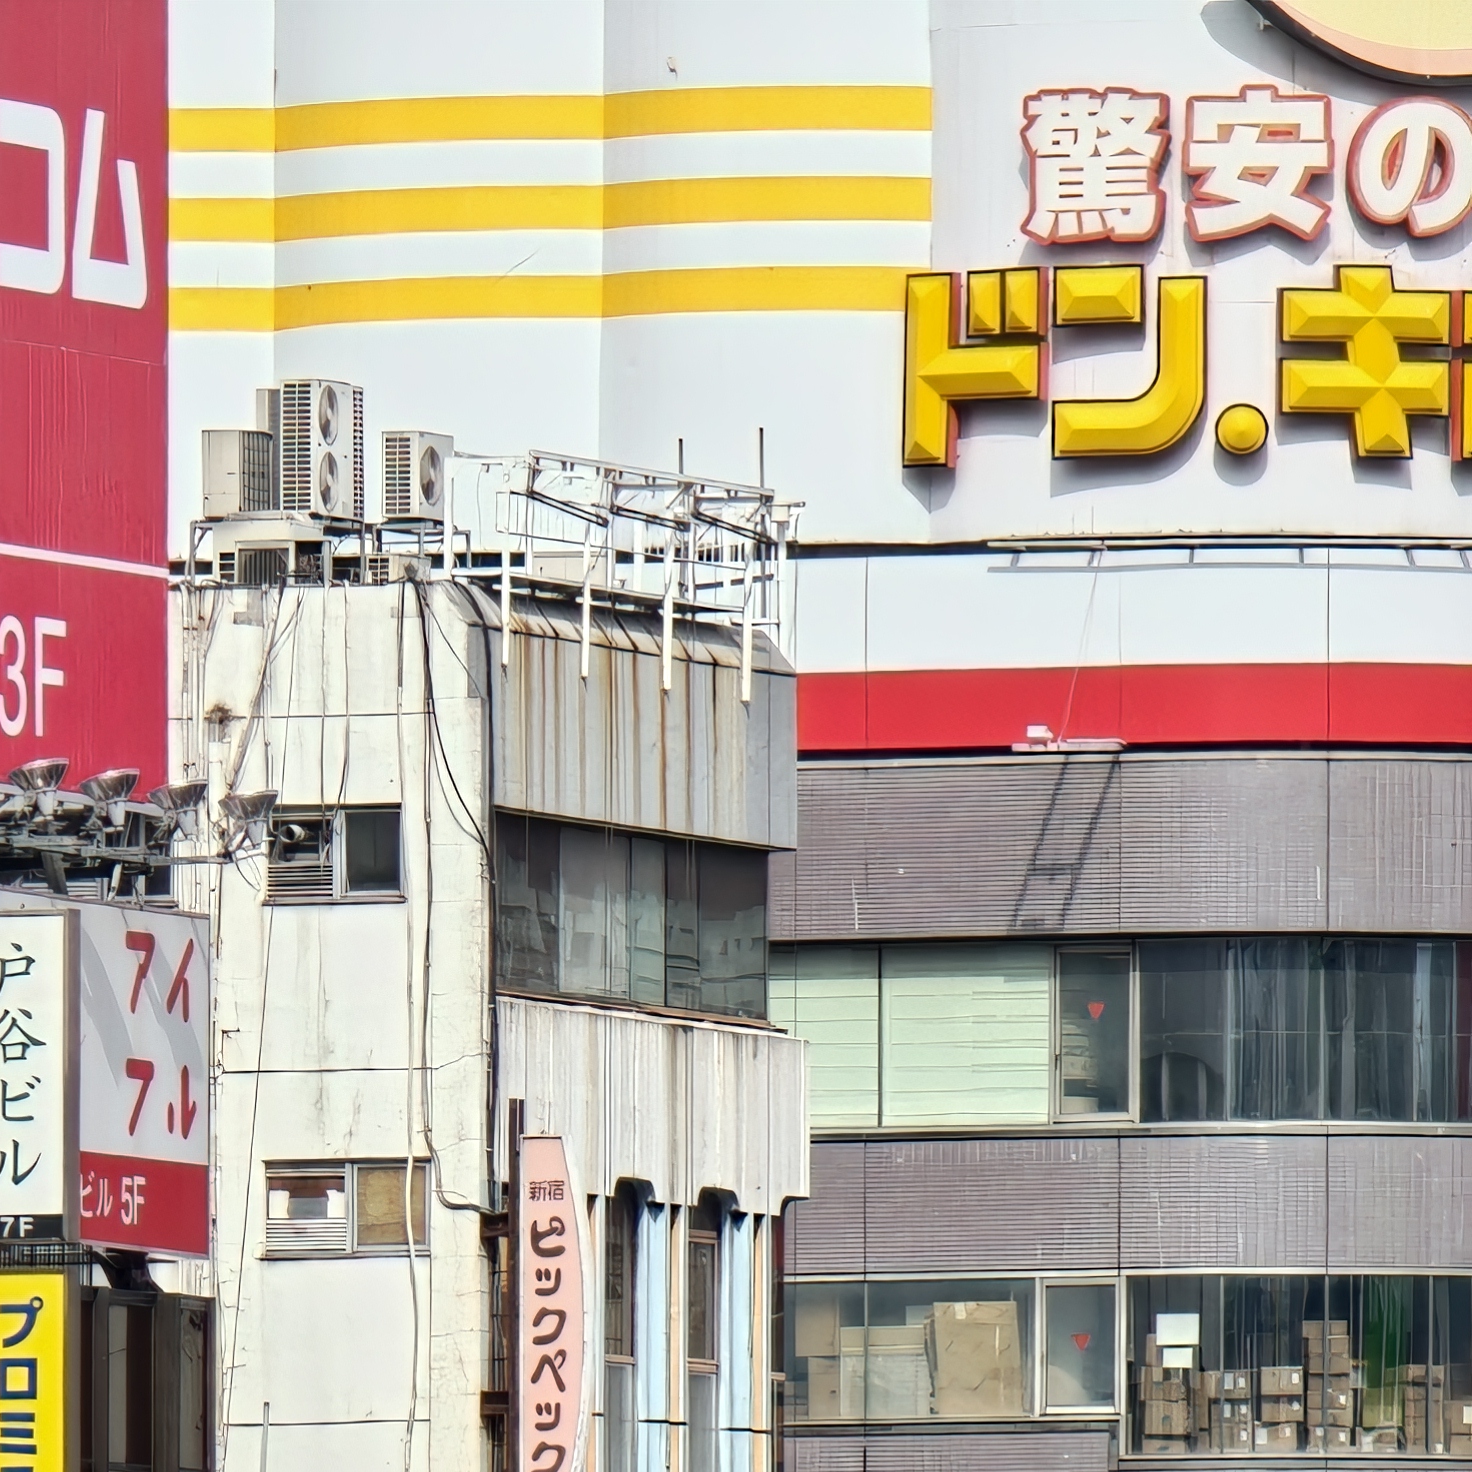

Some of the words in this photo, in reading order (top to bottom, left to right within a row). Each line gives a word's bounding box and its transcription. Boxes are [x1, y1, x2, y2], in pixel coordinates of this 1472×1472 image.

[1020, 85, 1472, 245] 驚安の
[902, 264, 1472, 468] ドン・キ
[126, 930, 194, 1023] アイ
[126, 1058, 197, 1140] フル
[0, 1217, 34, 1237] 7F
[121, 1175, 146, 1225] 5F
[528, 1180, 564, 1201] 新宿
